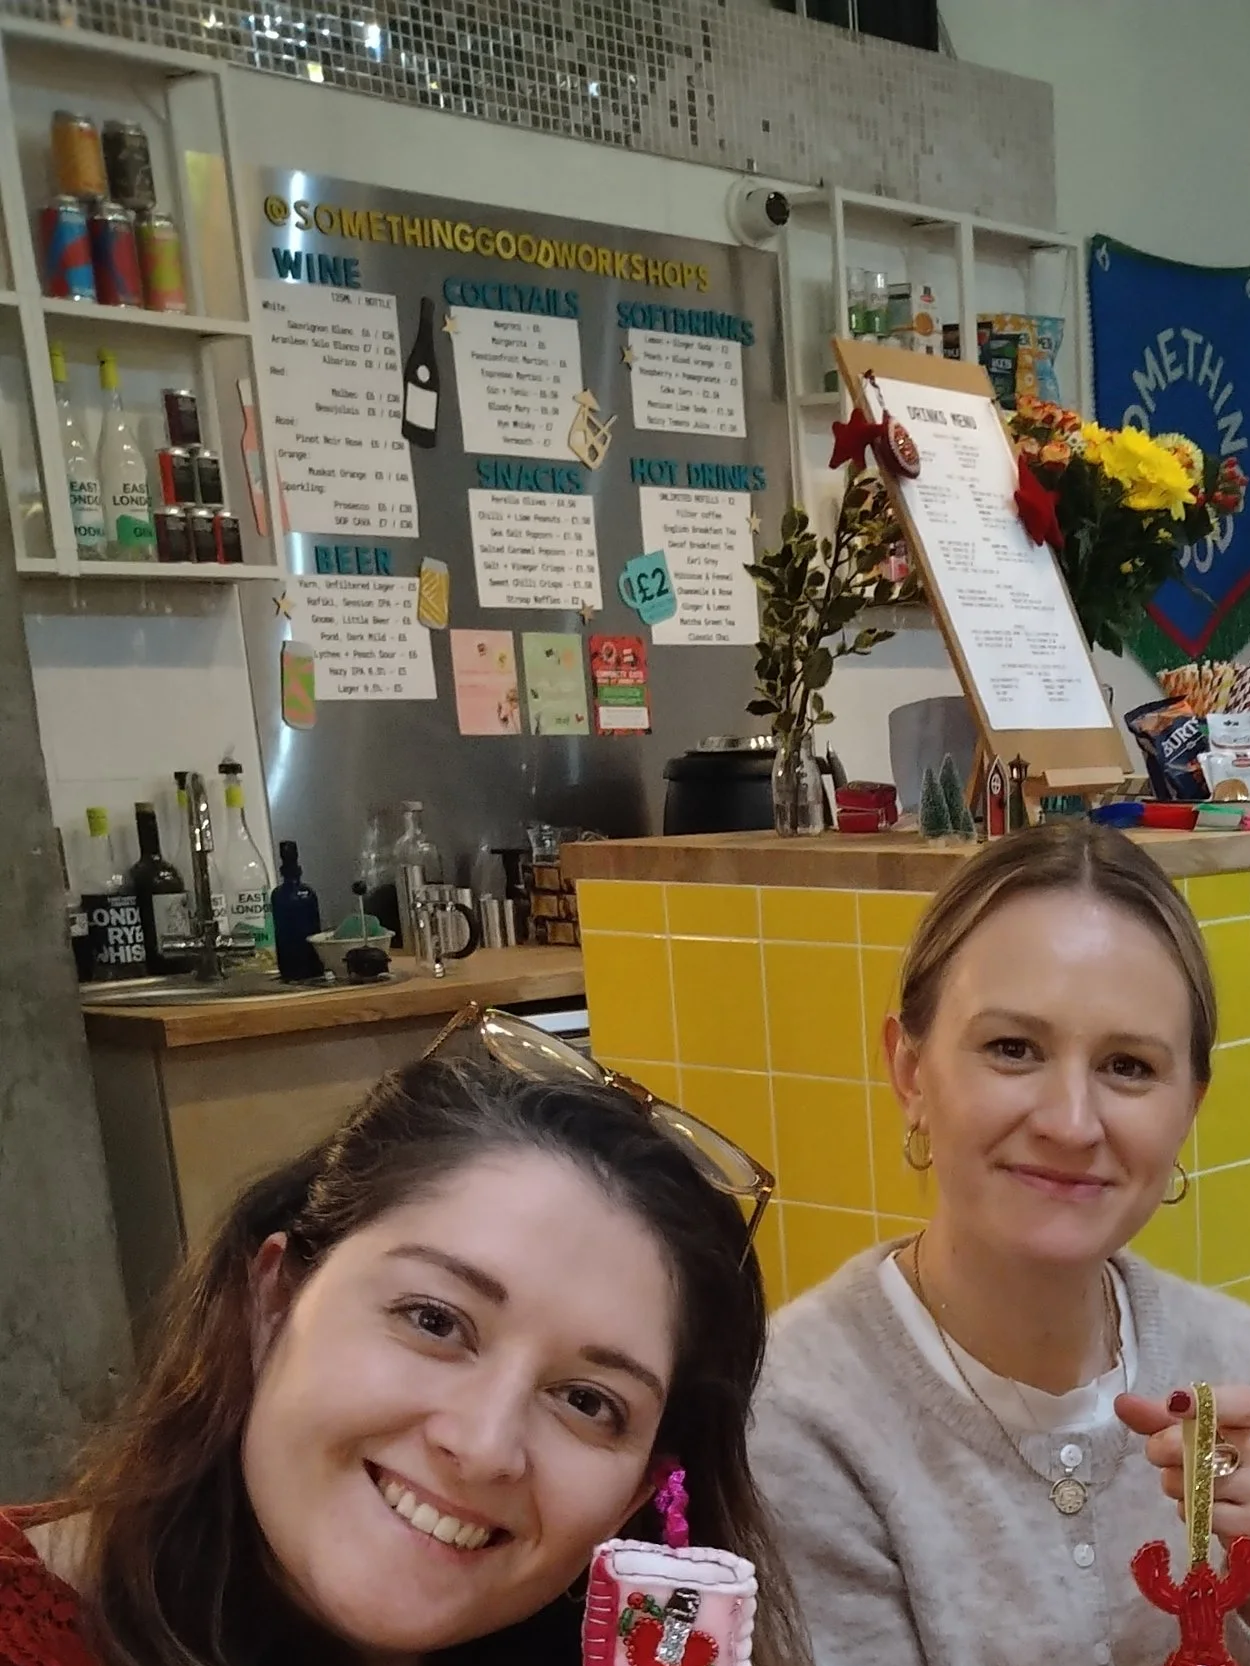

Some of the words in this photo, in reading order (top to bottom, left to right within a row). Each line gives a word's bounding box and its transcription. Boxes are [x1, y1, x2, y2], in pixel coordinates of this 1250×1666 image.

[264, 194, 710, 292] @SOMETHINGGOODWORKSHOPS
[272, 247, 362, 288] WINE
[443, 277, 580, 318] COCKTAILS
[617, 301, 755, 347] SOFTDRINKS
[907, 406, 948, 425] DRINKS
[951, 412, 977, 429] MENU
[296, 434, 319, 444] Pinot
[323, 436, 341, 445] Noir
[340, 469, 367, 480] Orange
[476, 457, 586, 494] SNACKS
[630, 457, 677, 486] HOT
[686, 462, 767, 491] DRINKS
[123, 483, 149, 494] EAST
[334, 501, 370, 511] Prosecco
[315, 546, 391, 576] BEER
[325, 581, 370, 590] Unfiltered
[373, 583, 395, 592] Lager
[637, 568, 669, 603] £2
[343, 598, 374, 607] Session
[378, 599, 391, 608] IPA
[343, 616, 368, 624] Little
[373, 616, 390, 625] Beer
[347, 632, 364, 641] Dark
[368, 632, 386, 641] Mild
[314, 651, 340, 659] Lychee
[353, 651, 375, 659] Peach
[379, 651, 396, 659] Sour
[329, 668, 347, 677] Hazy
[351, 667, 366, 676] IPA
[338, 684, 359, 695] Lager
[1161, 717, 1200, 757] BURTS
[239, 893, 267, 902] EAST
